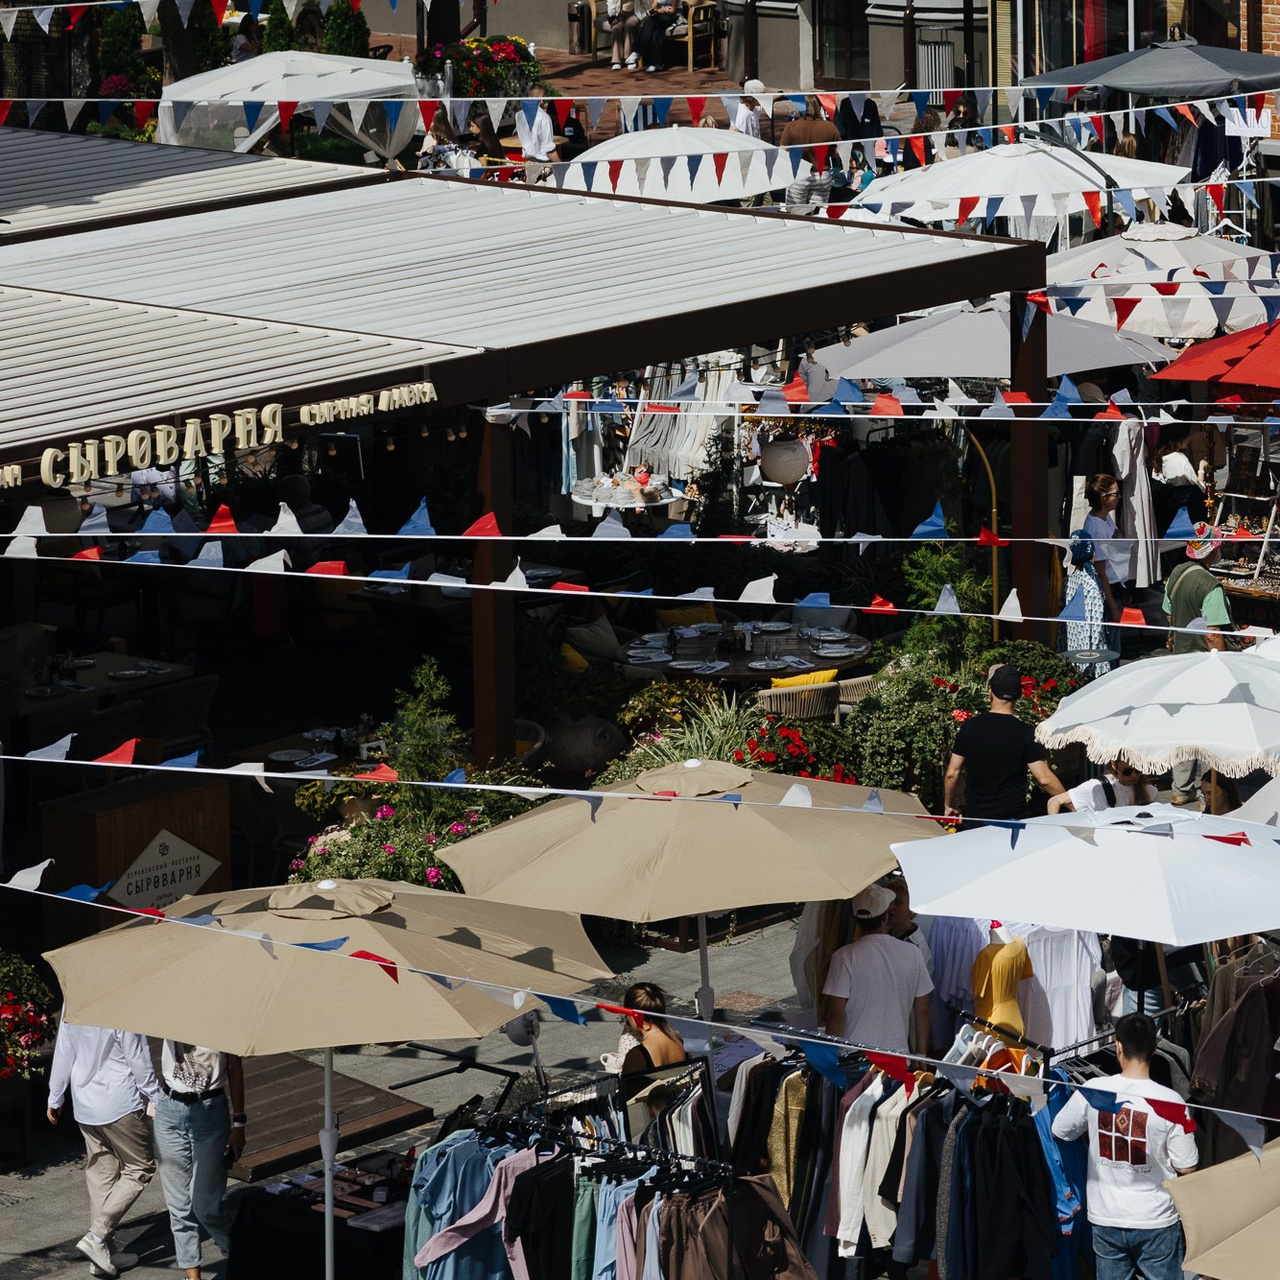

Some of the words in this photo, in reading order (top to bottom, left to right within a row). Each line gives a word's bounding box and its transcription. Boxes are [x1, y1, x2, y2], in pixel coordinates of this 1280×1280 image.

[300, 394, 374, 426] СЫРНАЯ
[378, 382, 438, 412] ЛАВКА
[41, 403, 284, 489] СЫРОВАРНЯ
[126, 864, 200, 896] СЫРОВАРНЯ
